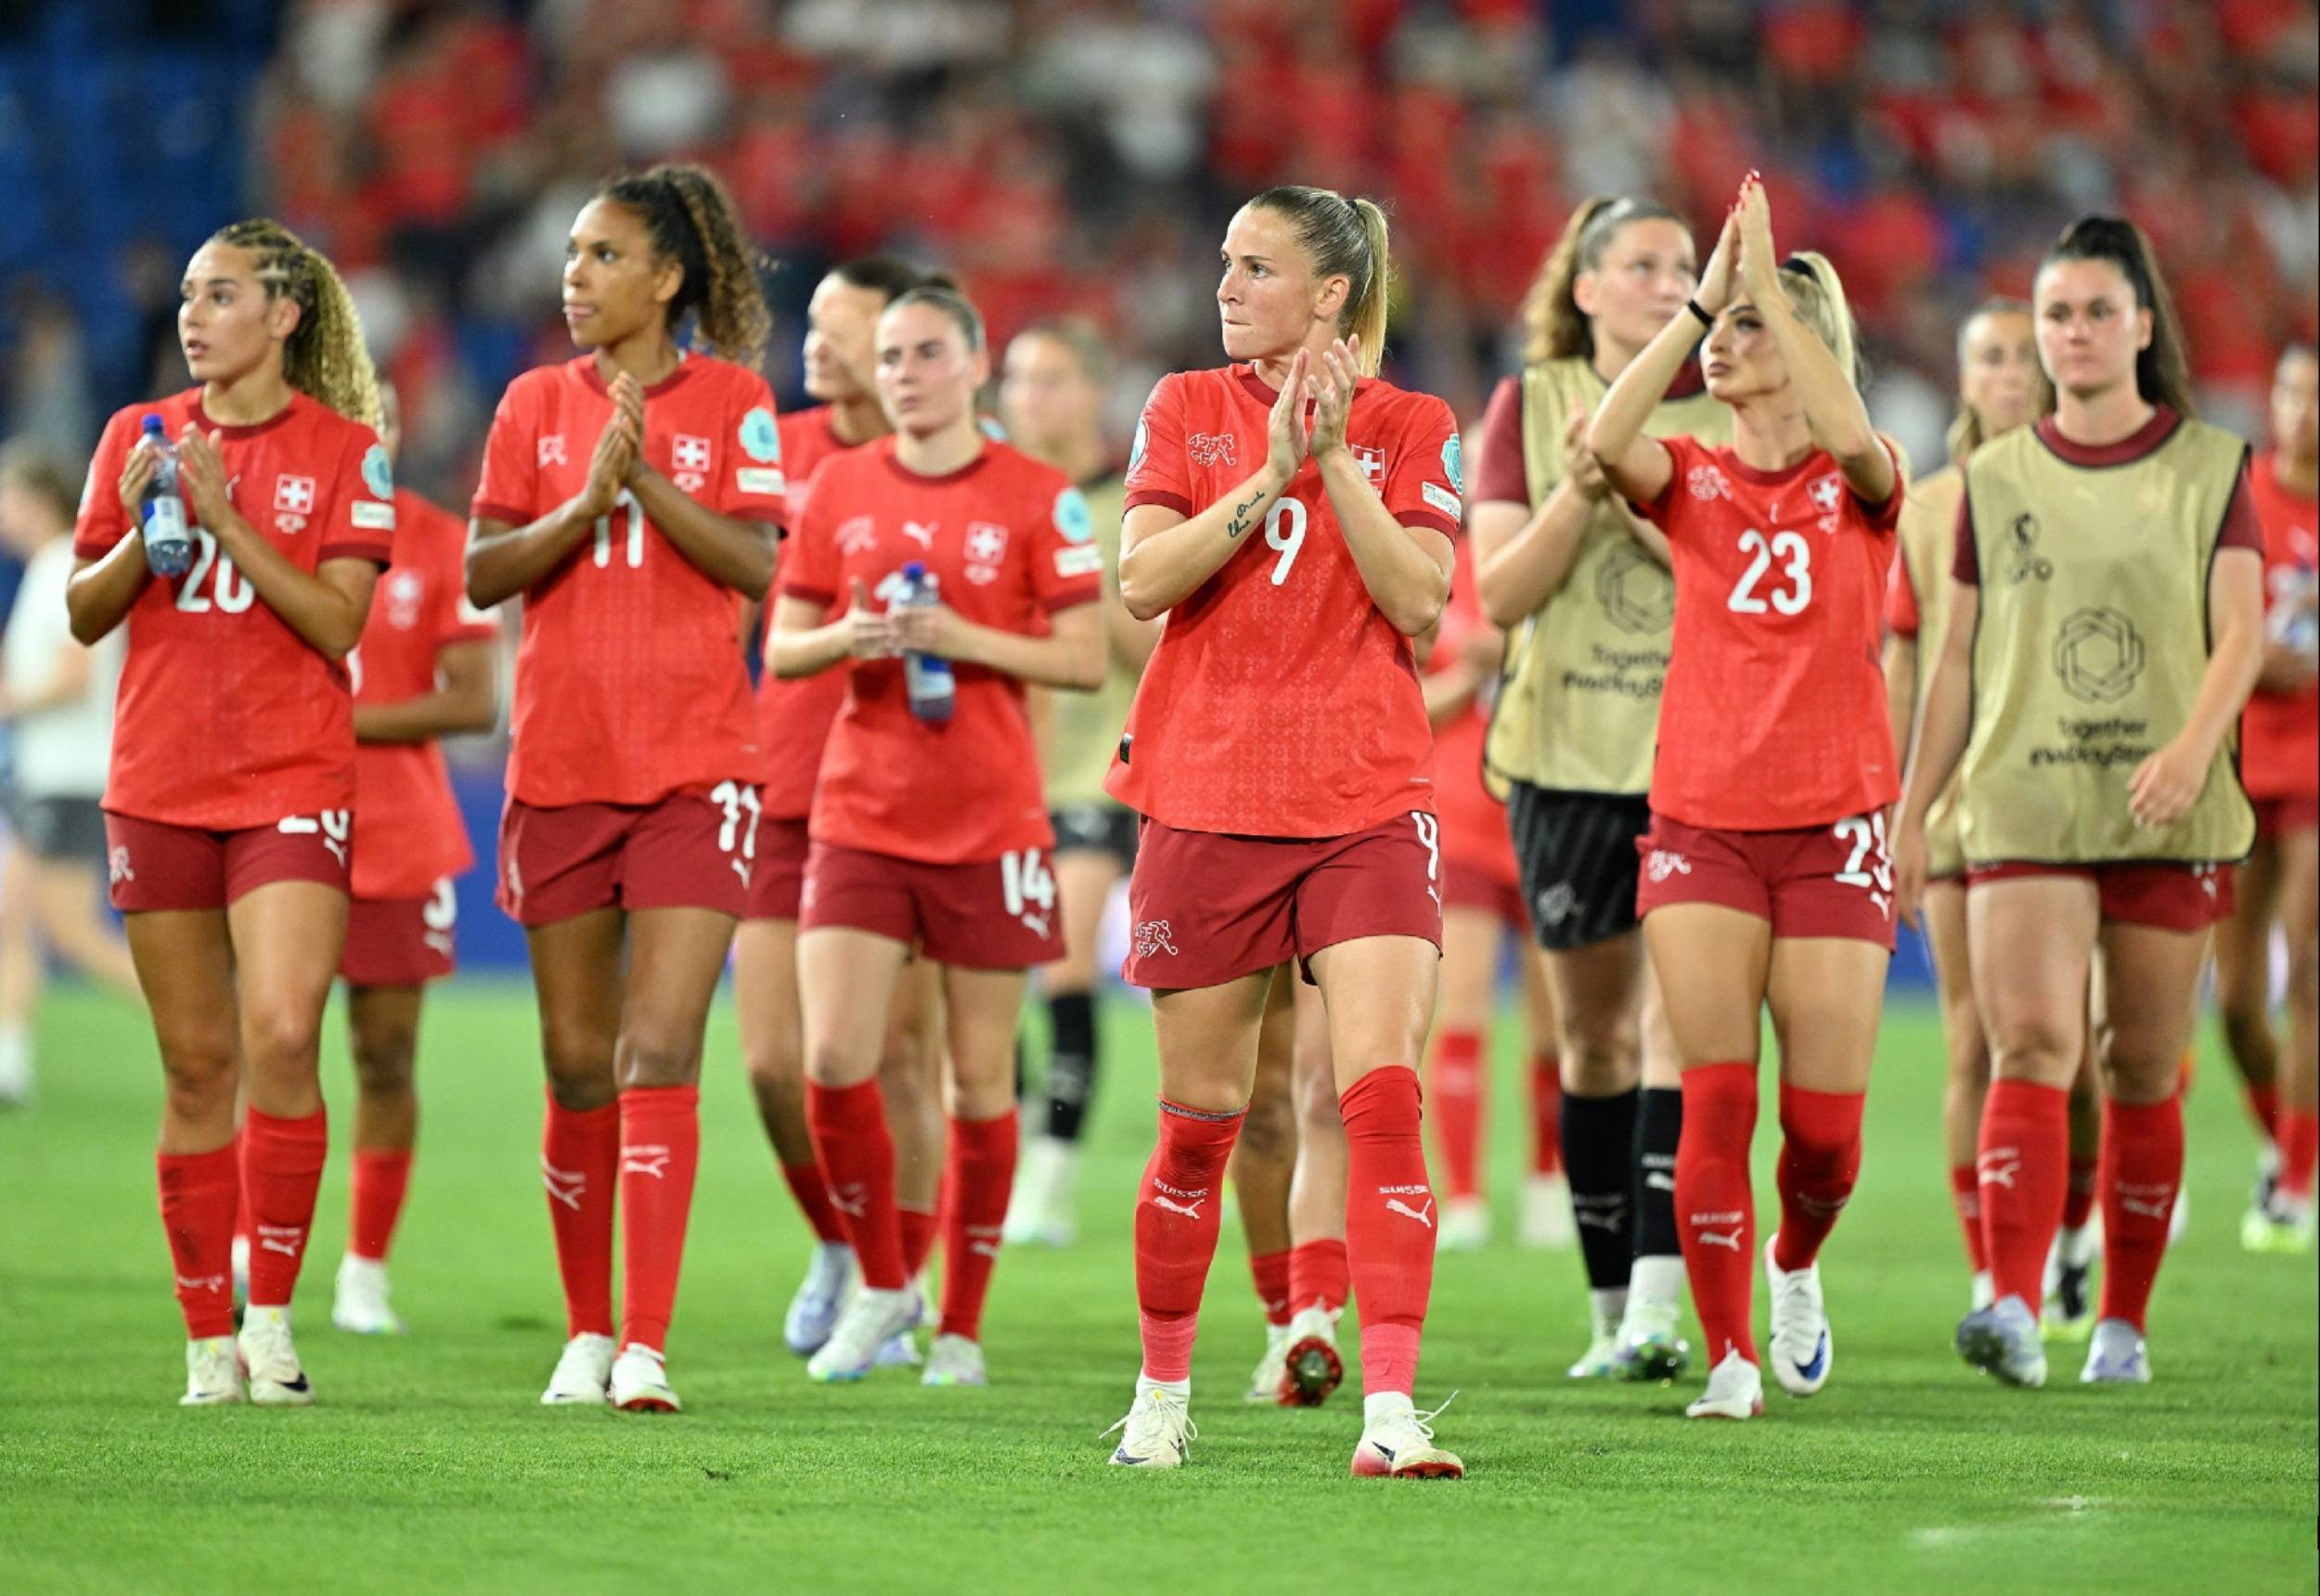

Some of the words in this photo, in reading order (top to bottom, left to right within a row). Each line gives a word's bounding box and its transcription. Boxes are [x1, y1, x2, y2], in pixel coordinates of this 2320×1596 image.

[175, 526, 255, 613] 20
[1265, 497, 1307, 586] 9
[1728, 528, 1811, 615] 23
[1592, 644, 1670, 671] Togethe
[710, 780, 762, 859] 11
[1002, 848, 1054, 916] 14
